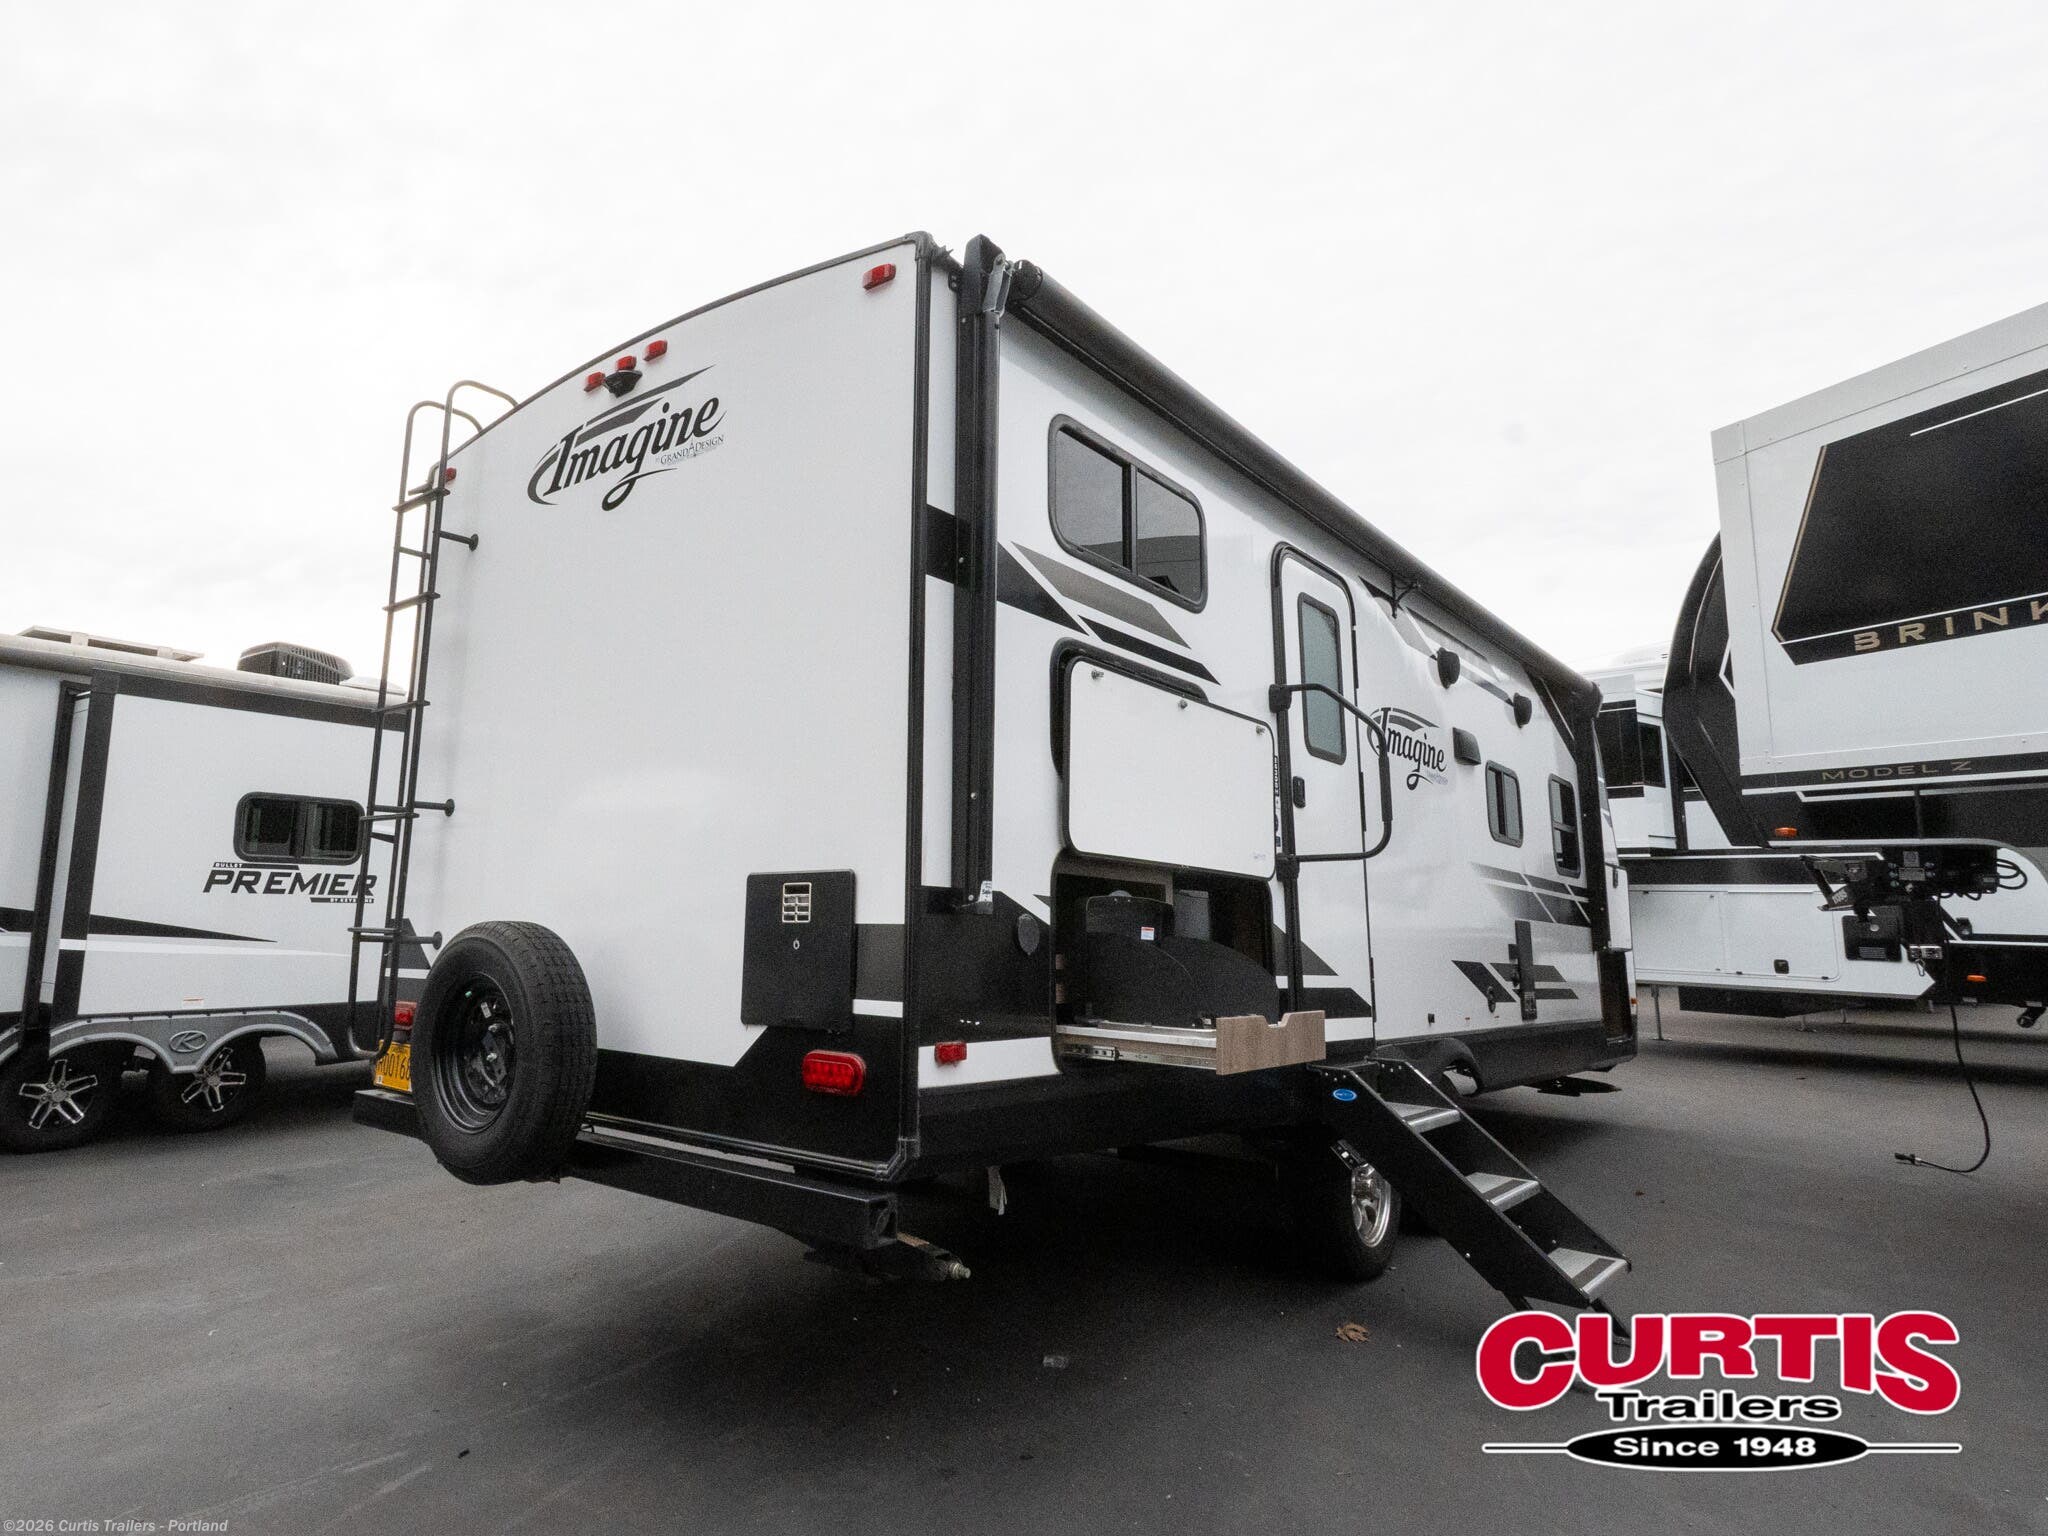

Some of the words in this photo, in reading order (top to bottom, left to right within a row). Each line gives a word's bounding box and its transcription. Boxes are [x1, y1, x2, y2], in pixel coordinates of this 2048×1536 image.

[534, 396, 728, 512] Imagine
[1375, 706, 1447, 791] Imagine
[1822, 764, 1938, 781] MODEL
[1951, 760, 1972, 772] Z
[202, 869, 378, 896] PREMIER
